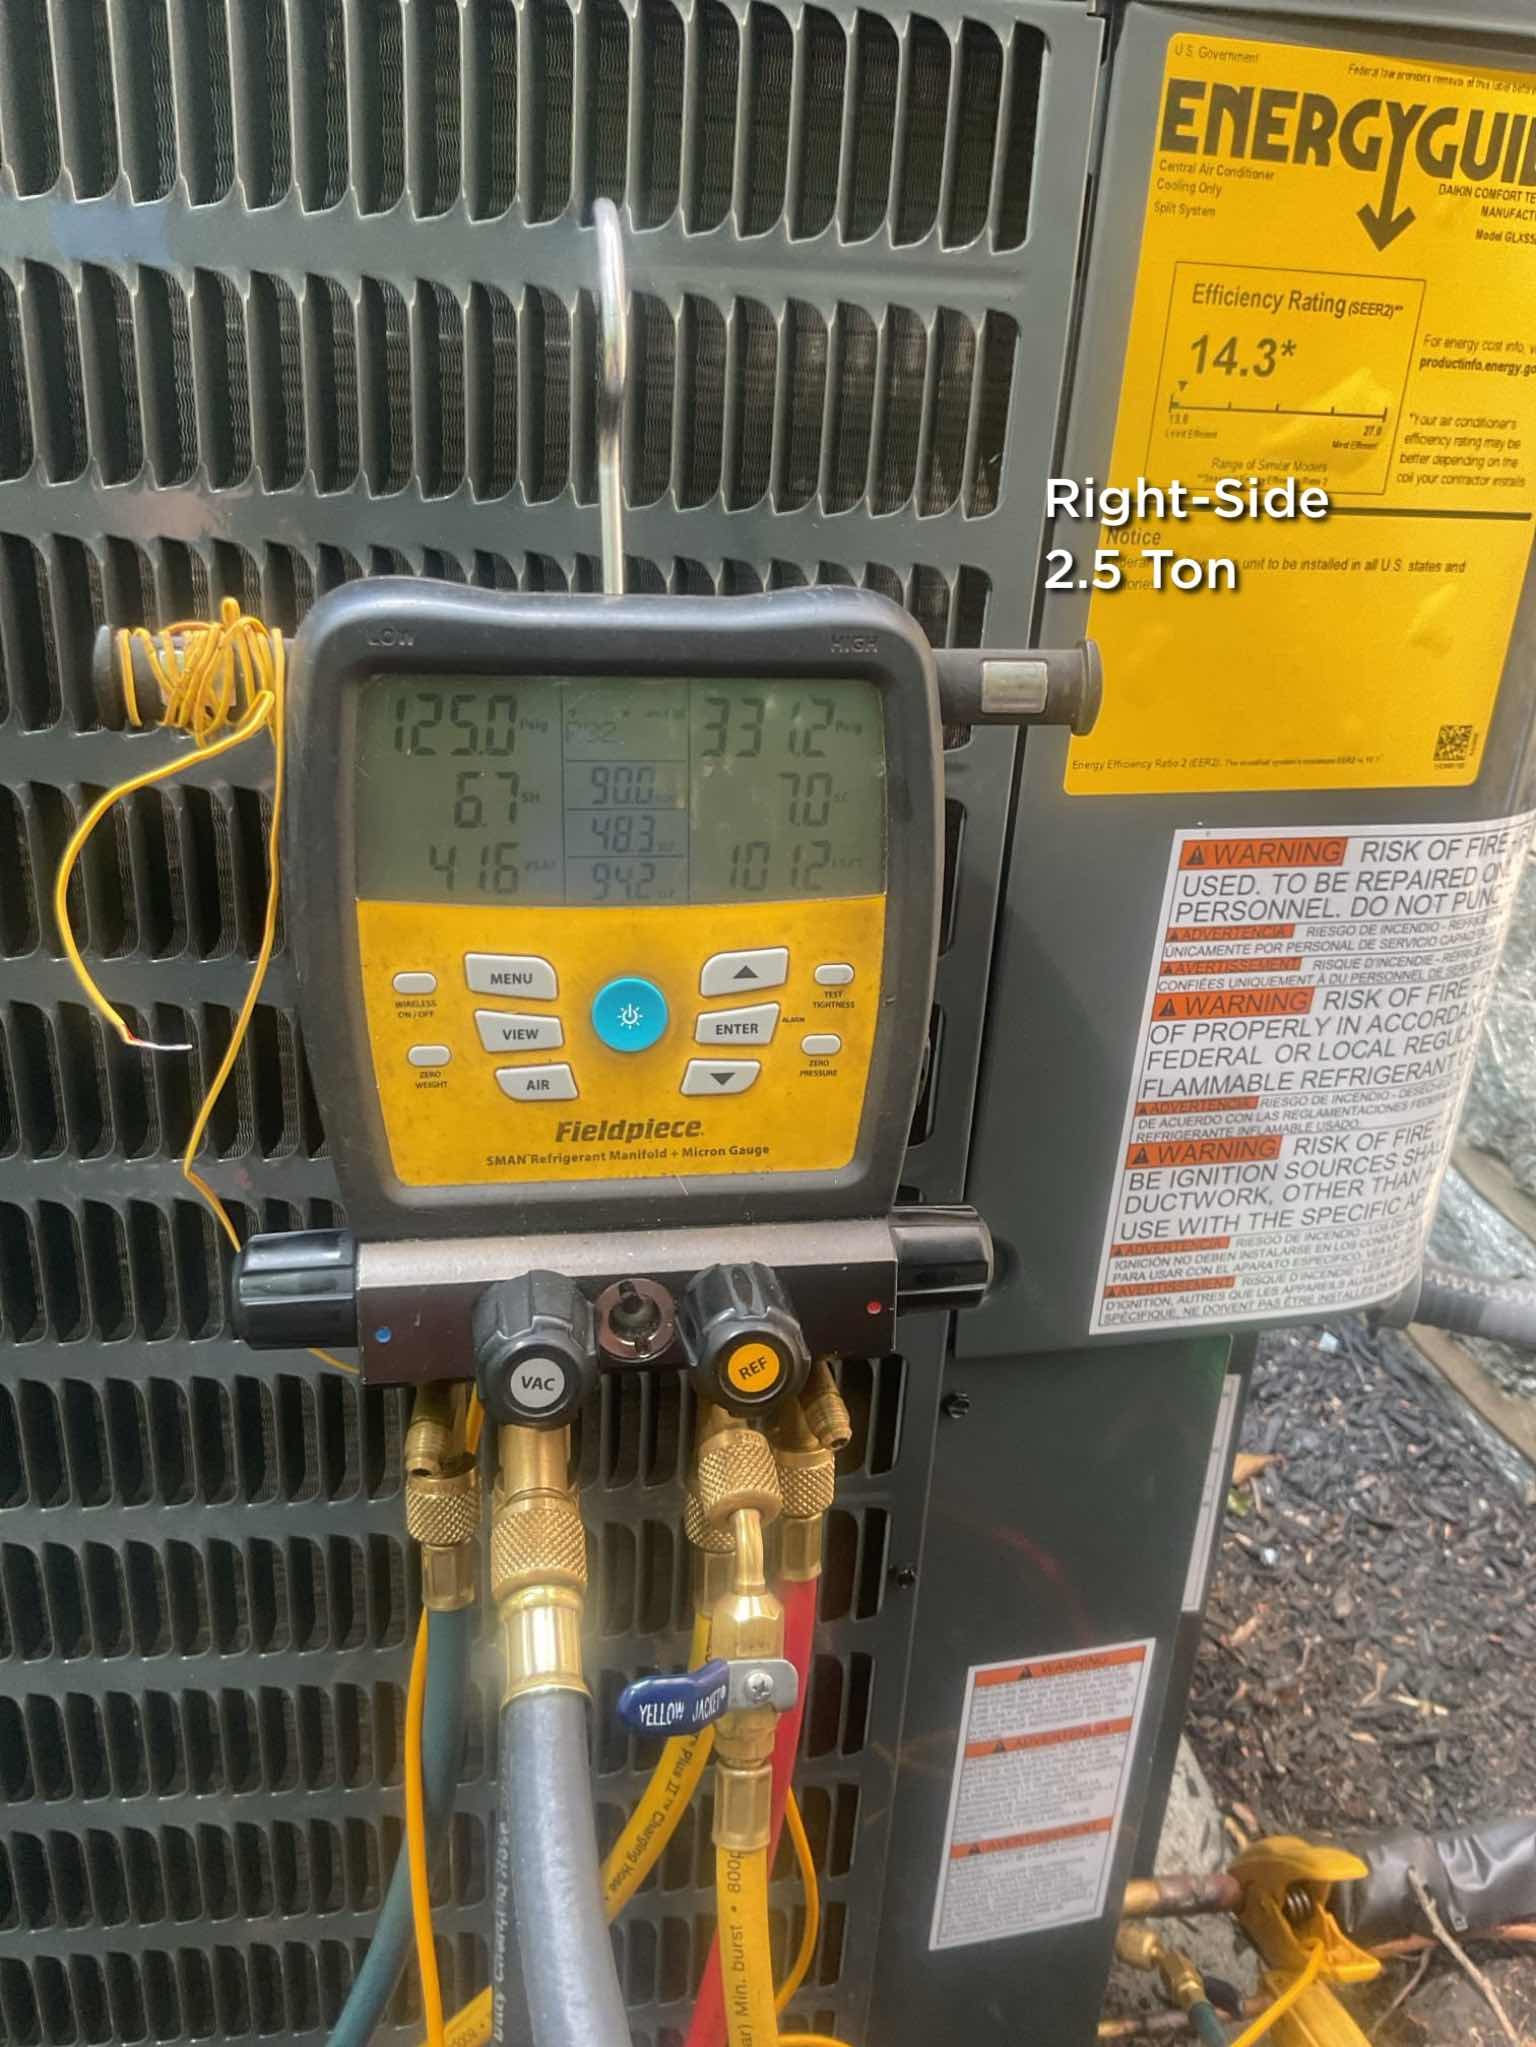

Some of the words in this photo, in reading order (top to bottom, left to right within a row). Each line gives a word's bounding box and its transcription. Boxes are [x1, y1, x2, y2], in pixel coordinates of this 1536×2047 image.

[1199, 47, 1259, 63] Government
[1159, 159, 1197, 173] Central
[1200, 163, 1214, 174] Air
[1216, 165, 1274, 181] Conditioner
[1156, 178, 1199, 195] Cooling
[1199, 181, 1222, 198] Only
[1439, 184, 1473, 198] DAIKIN
[1475, 187, 1522, 201] COMFORT
[1153, 201, 1176, 216] Split
[1180, 203, 1216, 219] System
[1192, 282, 1284, 314] Efficiency
[1288, 289, 1346, 319] Rating
[1424, 333, 1442, 348] For
[1444, 337, 1479, 352] energy
[1481, 339, 1503, 351] cost
[1404, 432, 1451, 447] efficiency
[1454, 436, 1482, 451] rating
[1507, 437, 1521, 449] be
[1400, 452, 1430, 465] better
[1432, 453, 1485, 469] depending
[1416, 474, 1439, 486] your
[1106, 527, 1161, 545] Notice
[1242, 558, 1265, 571] unit
[1268, 558, 1279, 571] to
[1282, 558, 1297, 571] be
[1300, 558, 1348, 572] installed
[1351, 558, 1361, 571] in
[1364, 558, 1377, 572] all
[1407, 559, 1441, 573] states
[1445, 559, 1466, 574] and
[1072, 759, 1106, 772] Energy
[1107, 758, 1152, 771] Efficiency
[1214, 841, 1342, 865] WARNING
[1360, 839, 1422, 863] RISK
[1427, 838, 1463, 861] OF
[1465, 833, 1509, 859] FIRE
[1182, 874, 1260, 897] USED.
[1273, 872, 1308, 894] TO
[1313, 871, 1350, 894] BE
[1355, 866, 1477, 892] REPAIRED
[1176, 897, 1341, 923] PERSONNEL.
[1350, 895, 1388, 918] DO
[1394, 893, 1449, 917] NOT
[1305, 925, 1355, 938] RIESGO
[1358, 924, 1378, 937] DE
[1380, 921, 1440, 936] INCENDIO
[1254, 942, 1283, 955] POR
[1286, 938, 1354, 954] PERSONAL
[1362, 938, 1378, 951] DE
[1379, 934, 1437, 950] SERVICIO
[1313, 958, 1361, 971] RISQUE
[490, 973, 533, 986] MENU
[1229, 974, 1314, 989] UNIQUEMENT
[1329, 973, 1348, 985] DU
[1350, 967, 1425, 985] PERSONNEL
[824, 990, 844, 998] TEST
[1185, 991, 1309, 1016] WARNING
[1323, 988, 1383, 1011] RISK
[1388, 986, 1422, 1008] OF
[1426, 977, 1471, 1004] FIRE
[395, 1001, 437, 1009] WIRELESS
[398, 1011, 411, 1019] ON
[418, 1010, 434, 1018] OFF
[813, 1001, 855, 1009] TIGHTNESS
[502, 1028, 539, 1041] VIEW
[715, 1023, 759, 1036] ENTER
[1150, 1023, 1187, 1045] OF
[1193, 1016, 1331, 1044] PROPERLY
[1336, 1015, 1361, 1035] IN
[809, 1059, 830, 1067] ZERO
[1147, 1046, 1262, 1071] FEDERAL
[1275, 1043, 1312, 1064] OR
[1318, 1038, 1396, 1062] LOCAL
[419, 1071, 441, 1079] ZERO
[800, 1069, 838, 1078] PRESSURE
[1142, 1071, 1295, 1099] FLAMMABLE
[1301, 1052, 1457, 1089] REFRIGERANT
[415, 1081, 448, 1089] WEIGHT
[526, 1079, 550, 1091] AIR
[1260, 1094, 1310, 1108] RIESGO
[1312, 1093, 1329, 1106] DE
[1331, 1089, 1389, 1104] INCENDIO
[1138, 1118, 1156, 1130] DE
[1158, 1114, 1223, 1129] ACUERDO
[1225, 1113, 1254, 1125] CON
[1255, 1110, 1280, 1123] LAS
[555, 1118, 703, 1144] Fieldpiece
[1136, 1126, 1234, 1143] REFRIGERANTE
[1236, 1121, 1313, 1137] INFLAMABLE
[1158, 1138, 1277, 1163] WARNING
[1294, 1134, 1351, 1156] RISK
[1356, 1131, 1389, 1152] OF
[1393, 1123, 1436, 1149] FIRE
[530, 1153, 606, 1166] Refrigerant
[608, 1147, 668, 1161] Manifold
[682, 1146, 727, 1158] Micron
[729, 1145, 770, 1158] Gauge
[1128, 1170, 1162, 1191] BE
[1170, 1162, 1279, 1189] IGNITION
[1284, 1152, 1398, 1180] SOURCES
[1124, 1186, 1273, 1215] DUCTWORK,
[1282, 1178, 1365, 1203] OTHER
[1372, 1167, 1422, 1195] THAN
[1121, 1218, 1171, 1241] USE
[1178, 1213, 1241, 1236] WITH
[1248, 1208, 1296, 1231] THE
[1300, 1196, 1401, 1227] SPECIFIC
[1113, 1269, 1146, 1283] PARA
[1149, 1266, 1183, 1281] USAR
[1185, 1263, 1212, 1277] CON
[738, 1356, 769, 1380] REF
[521, 1375, 556, 1391] VAC
[640, 1701, 685, 1726] YELLOW
[672, 1744, 693, 1778] Plus
[630, 1809, 665, 1864] Charging
[610, 1865, 633, 1893] Hose
[732, 1924, 745, 1972] burst
[735, 1979, 750, 2018] Min.
